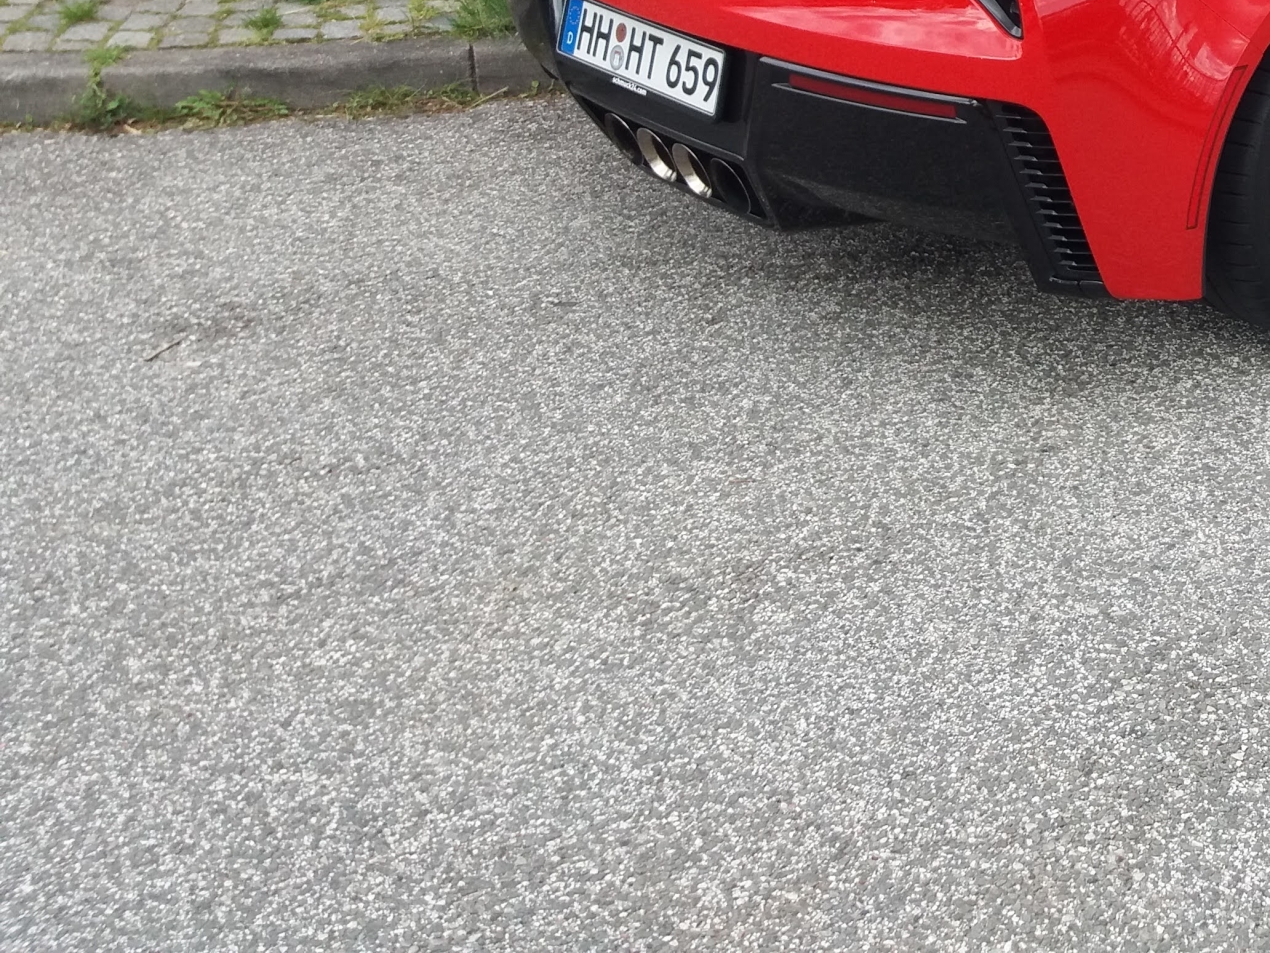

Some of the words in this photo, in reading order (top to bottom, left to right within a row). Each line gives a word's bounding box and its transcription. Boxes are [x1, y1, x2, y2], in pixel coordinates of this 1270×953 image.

[576, 8, 614, 62] HH
[624, 27, 665, 80] HT
[666, 44, 719, 102] 659
